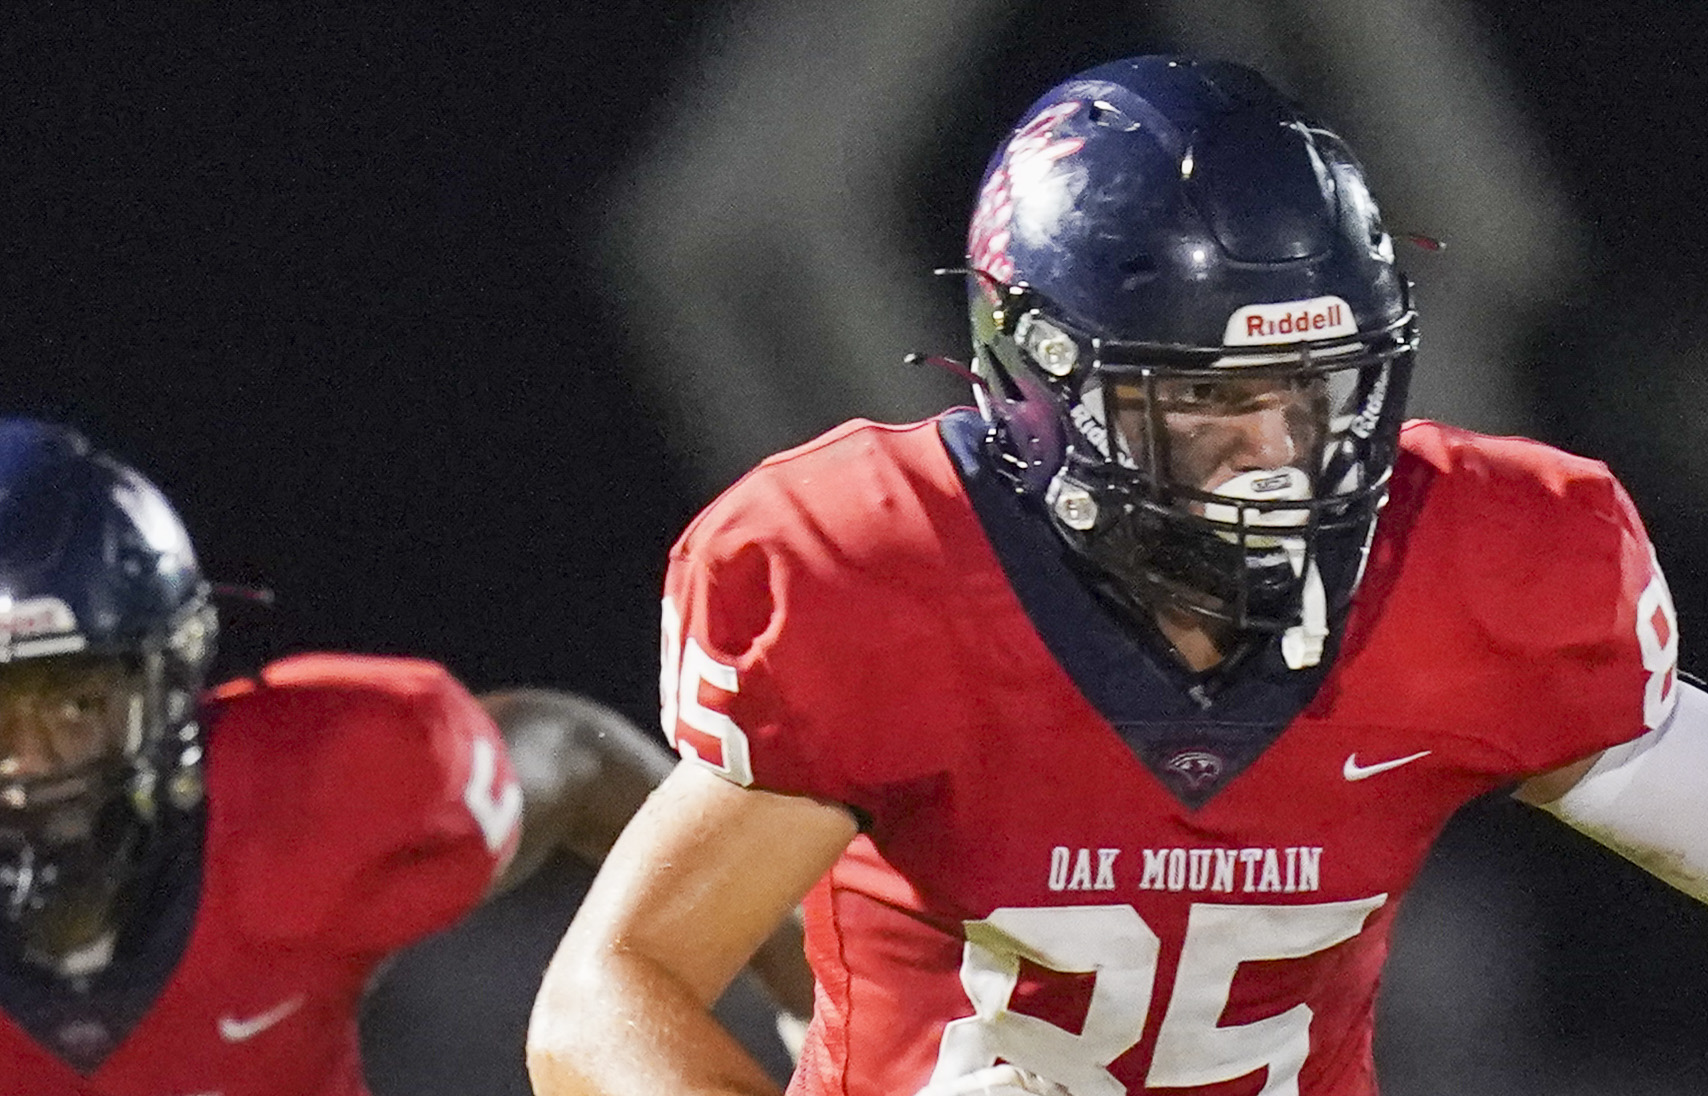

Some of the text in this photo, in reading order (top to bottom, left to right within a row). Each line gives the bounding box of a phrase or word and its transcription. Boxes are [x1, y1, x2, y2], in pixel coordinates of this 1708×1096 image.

[1246, 304, 1342, 337] Riddell
[1048, 846, 1323, 893] OAK MOUNTAIN
